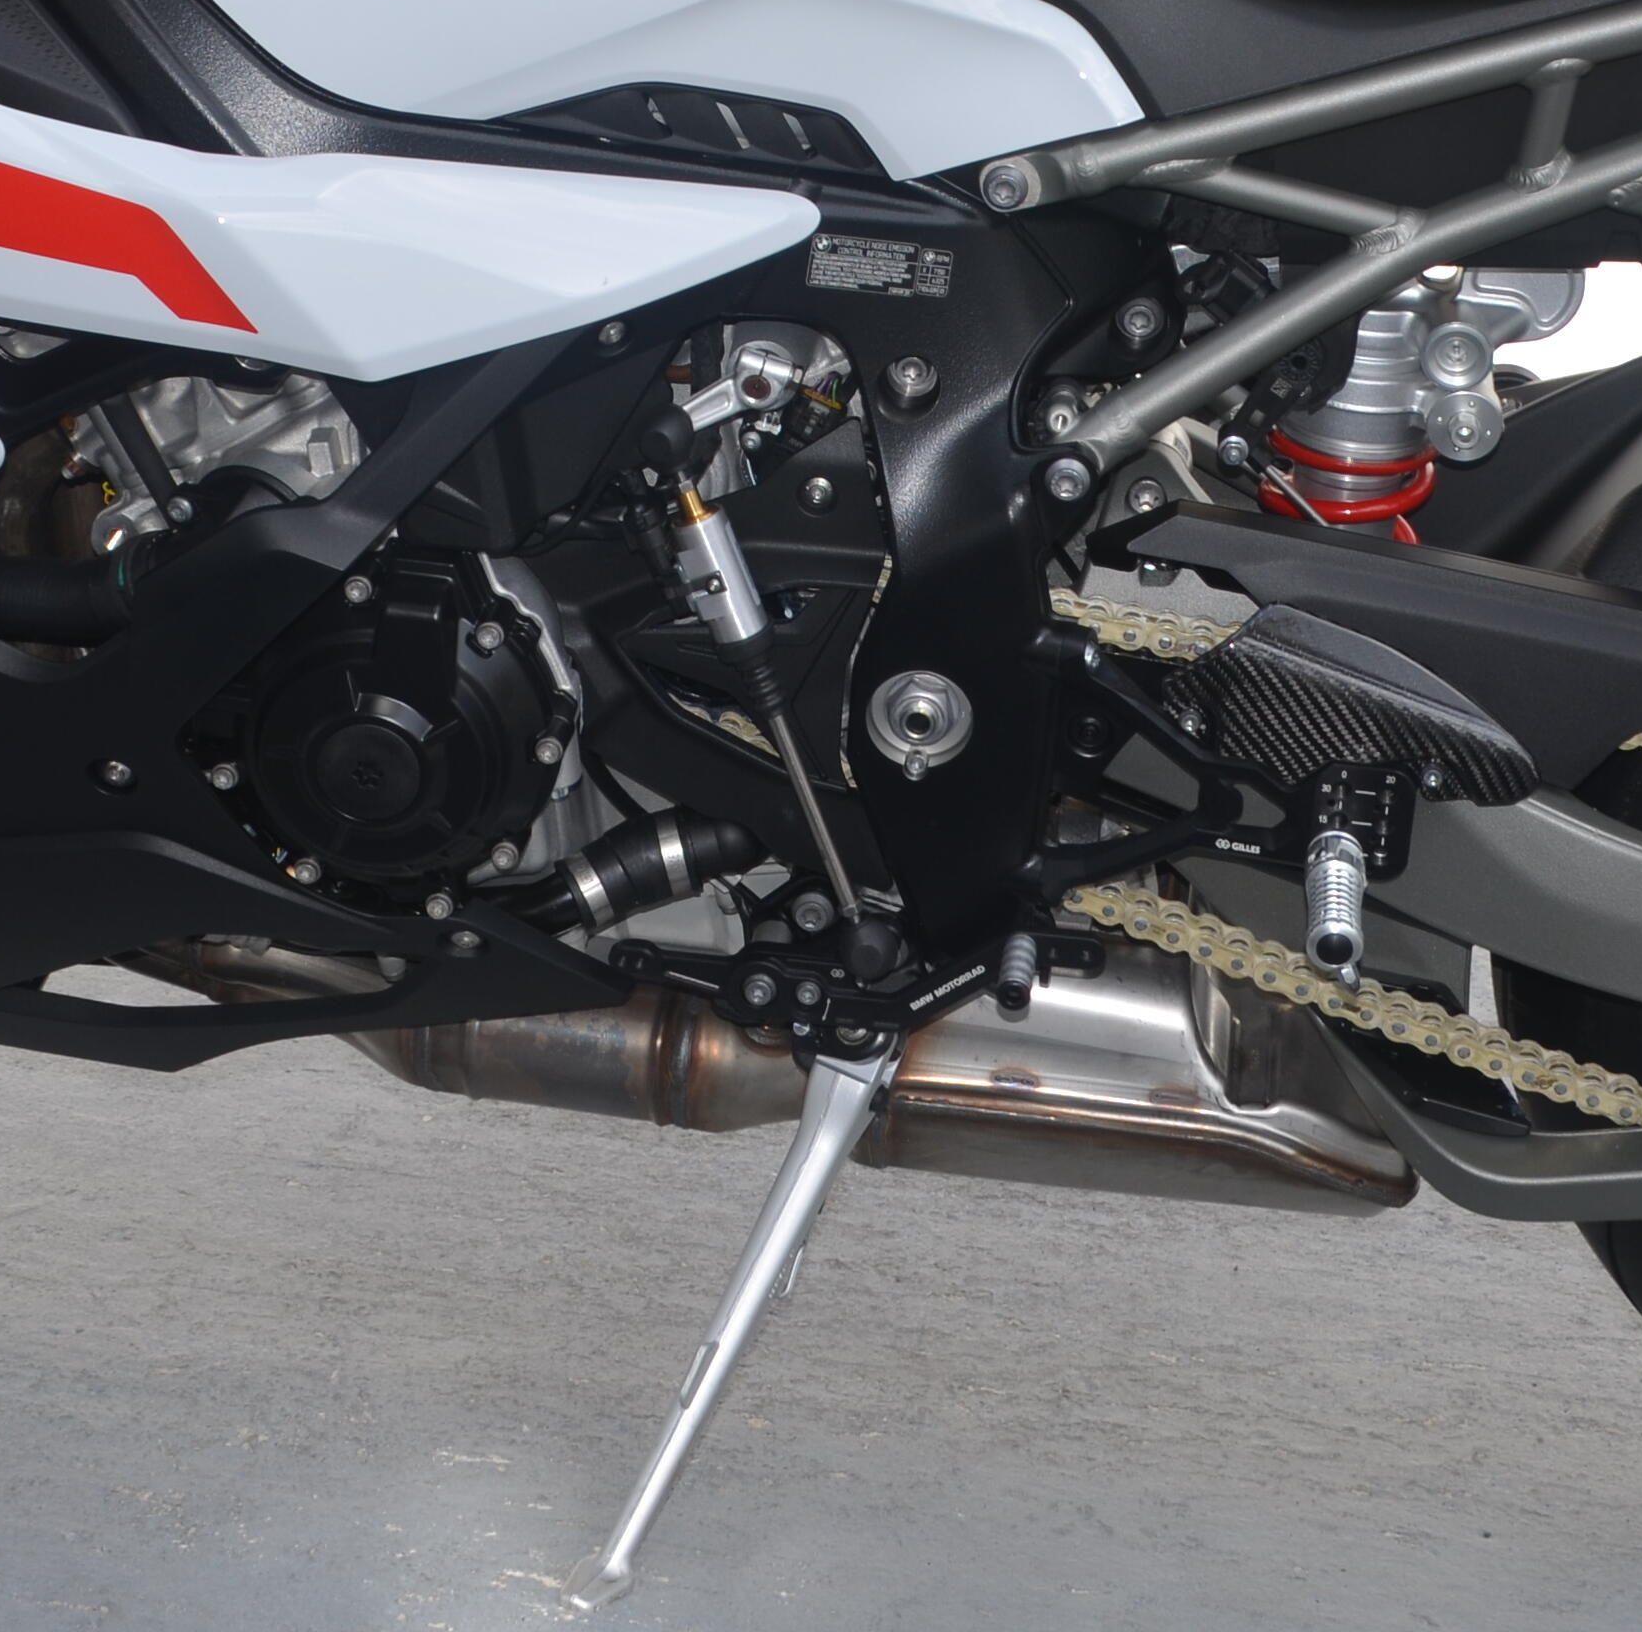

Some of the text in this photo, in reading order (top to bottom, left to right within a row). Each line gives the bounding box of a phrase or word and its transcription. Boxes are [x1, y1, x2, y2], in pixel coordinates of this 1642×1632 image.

[832, 238, 915, 254] MOTORCYCLE NOISE EMISSION
[837, 247, 906, 260] CONTROL INFORMATION
[1341, 770, 1396, 784] 0 20
[1321, 783, 1332, 793] 30
[1231, 841, 1261, 855] GILLES
[909, 965, 986, 1011] BMW MOTORRAD
